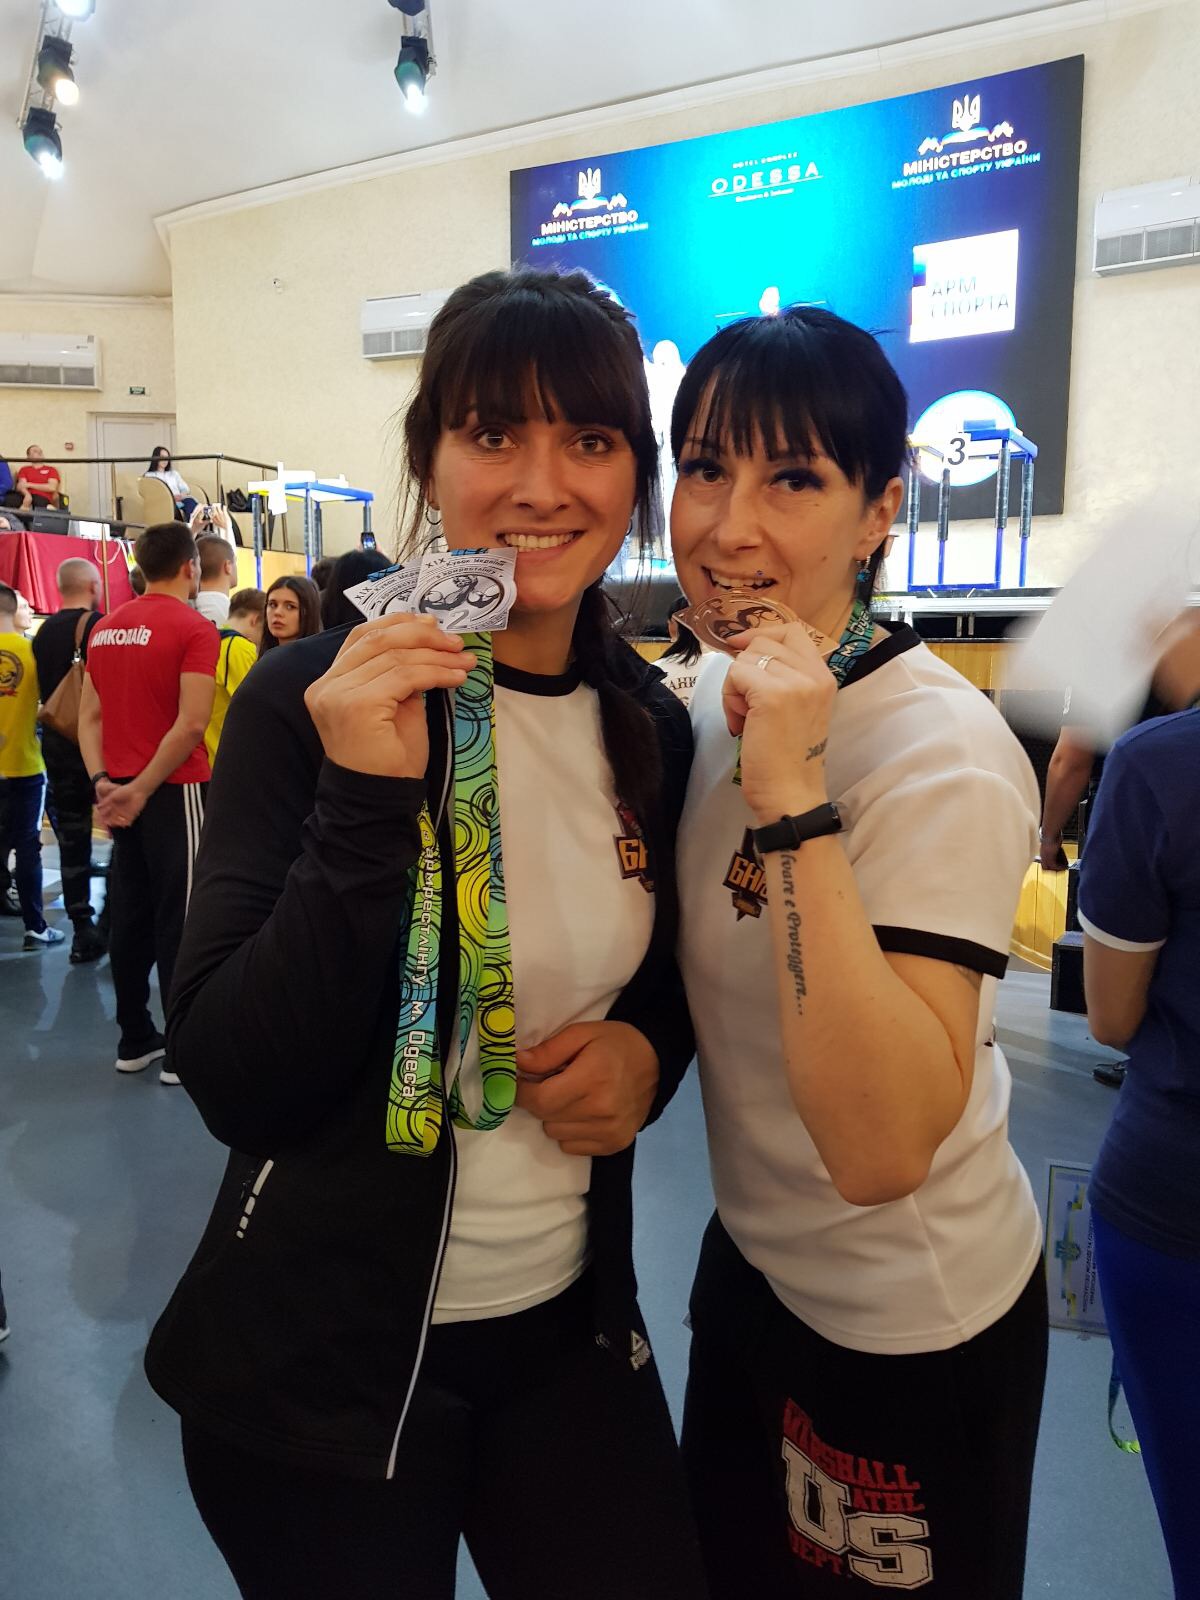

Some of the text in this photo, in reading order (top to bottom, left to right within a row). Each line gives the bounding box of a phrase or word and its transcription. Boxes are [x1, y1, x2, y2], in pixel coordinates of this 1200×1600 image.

[891, 152, 1041, 190] МОЛОДІ ТА СПОРТУ УКРАЇНИ
[903, 140, 1028, 176] МІНІСТЕРСТВО
[711, 161, 819, 194] ODESSA
[540, 209, 639, 236] МІНІСТЕРСТВО
[931, 275, 977, 297] АРМ
[947, 437, 966, 466] 3
[447, 608, 469, 630] 2
[90, 624, 153, 648] МИКОЛАЇВ
[401, 1030, 426, 1099] Одеса
